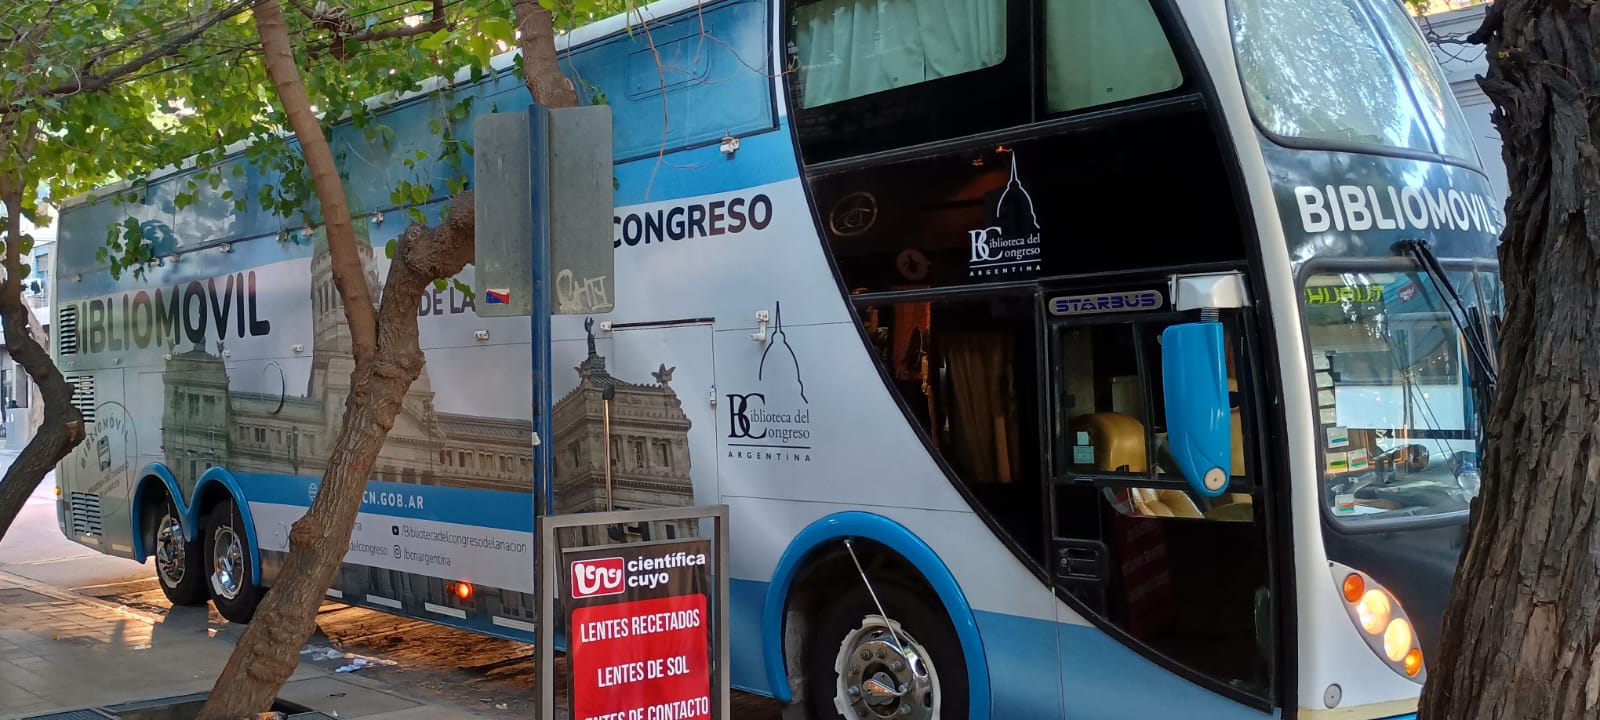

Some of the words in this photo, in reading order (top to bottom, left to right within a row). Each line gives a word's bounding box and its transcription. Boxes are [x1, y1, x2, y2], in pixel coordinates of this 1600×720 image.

[1294, 184, 1497, 235] BIBLIOMOVIL
[1027, 232, 1041, 246] del
[969, 264, 1042, 277] ARGENTINA
[419, 289, 444, 317] DE
[1055, 292, 1156, 313] STARBUS
[794, 409, 810, 424] del
[727, 450, 811, 462] ARGENTINA
[362, 490, 425, 510] CN.GOB.AR
[627, 551, 706, 572] científica
[627, 571, 669, 589] cuyo
[580, 617, 629, 643] LENTES
[631, 608, 700, 636] RECETADOS
[597, 661, 645, 688] LENTES
[647, 658, 664, 680] DE
[667, 655, 690, 676] SOL
[647, 696, 709, 720] CONTACTO
